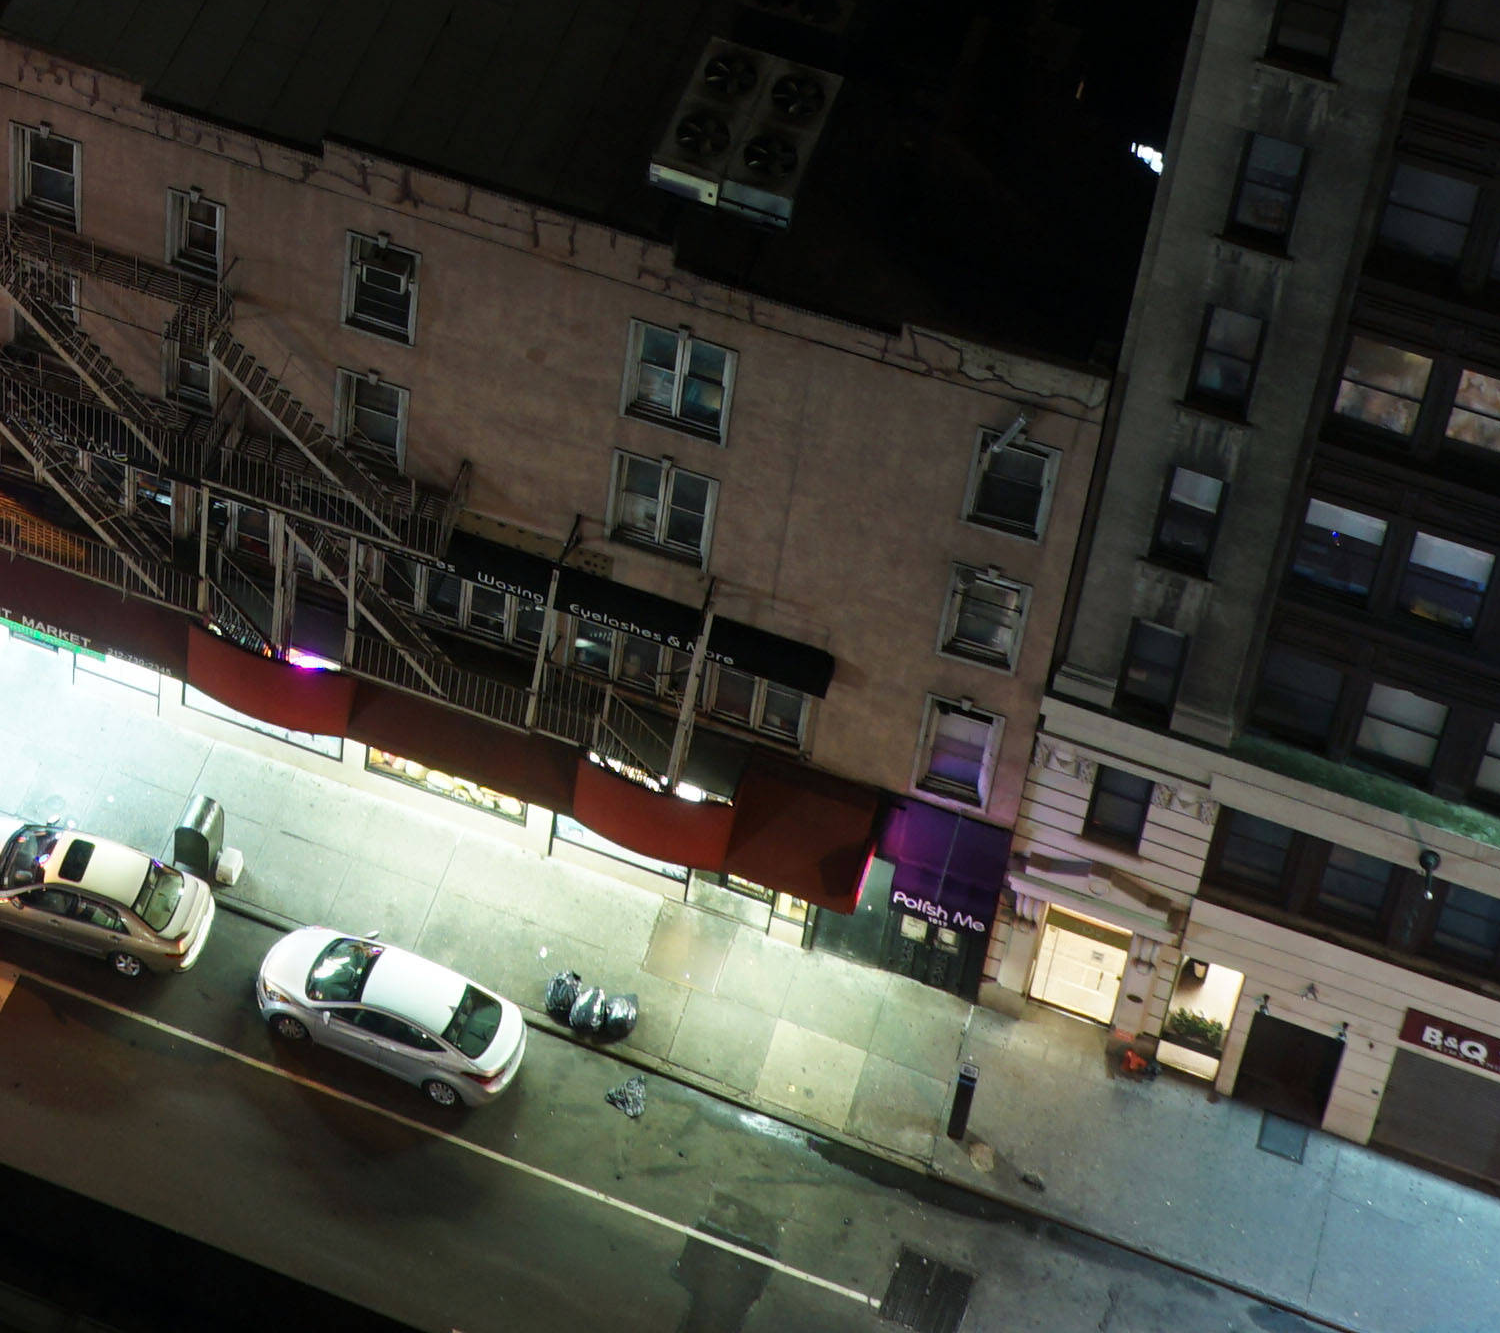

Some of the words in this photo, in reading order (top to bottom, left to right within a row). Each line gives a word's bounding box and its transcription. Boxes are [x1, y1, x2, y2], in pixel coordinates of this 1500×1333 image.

[477, 572, 545, 605] Waxing
[569, 603, 662, 644] Eyelashes
[667, 634, 681, 648] &
[21, 615, 92, 649] MARKET
[893, 891, 948, 921] Polish
[1422, 1025, 1490, 1062] B&Q
